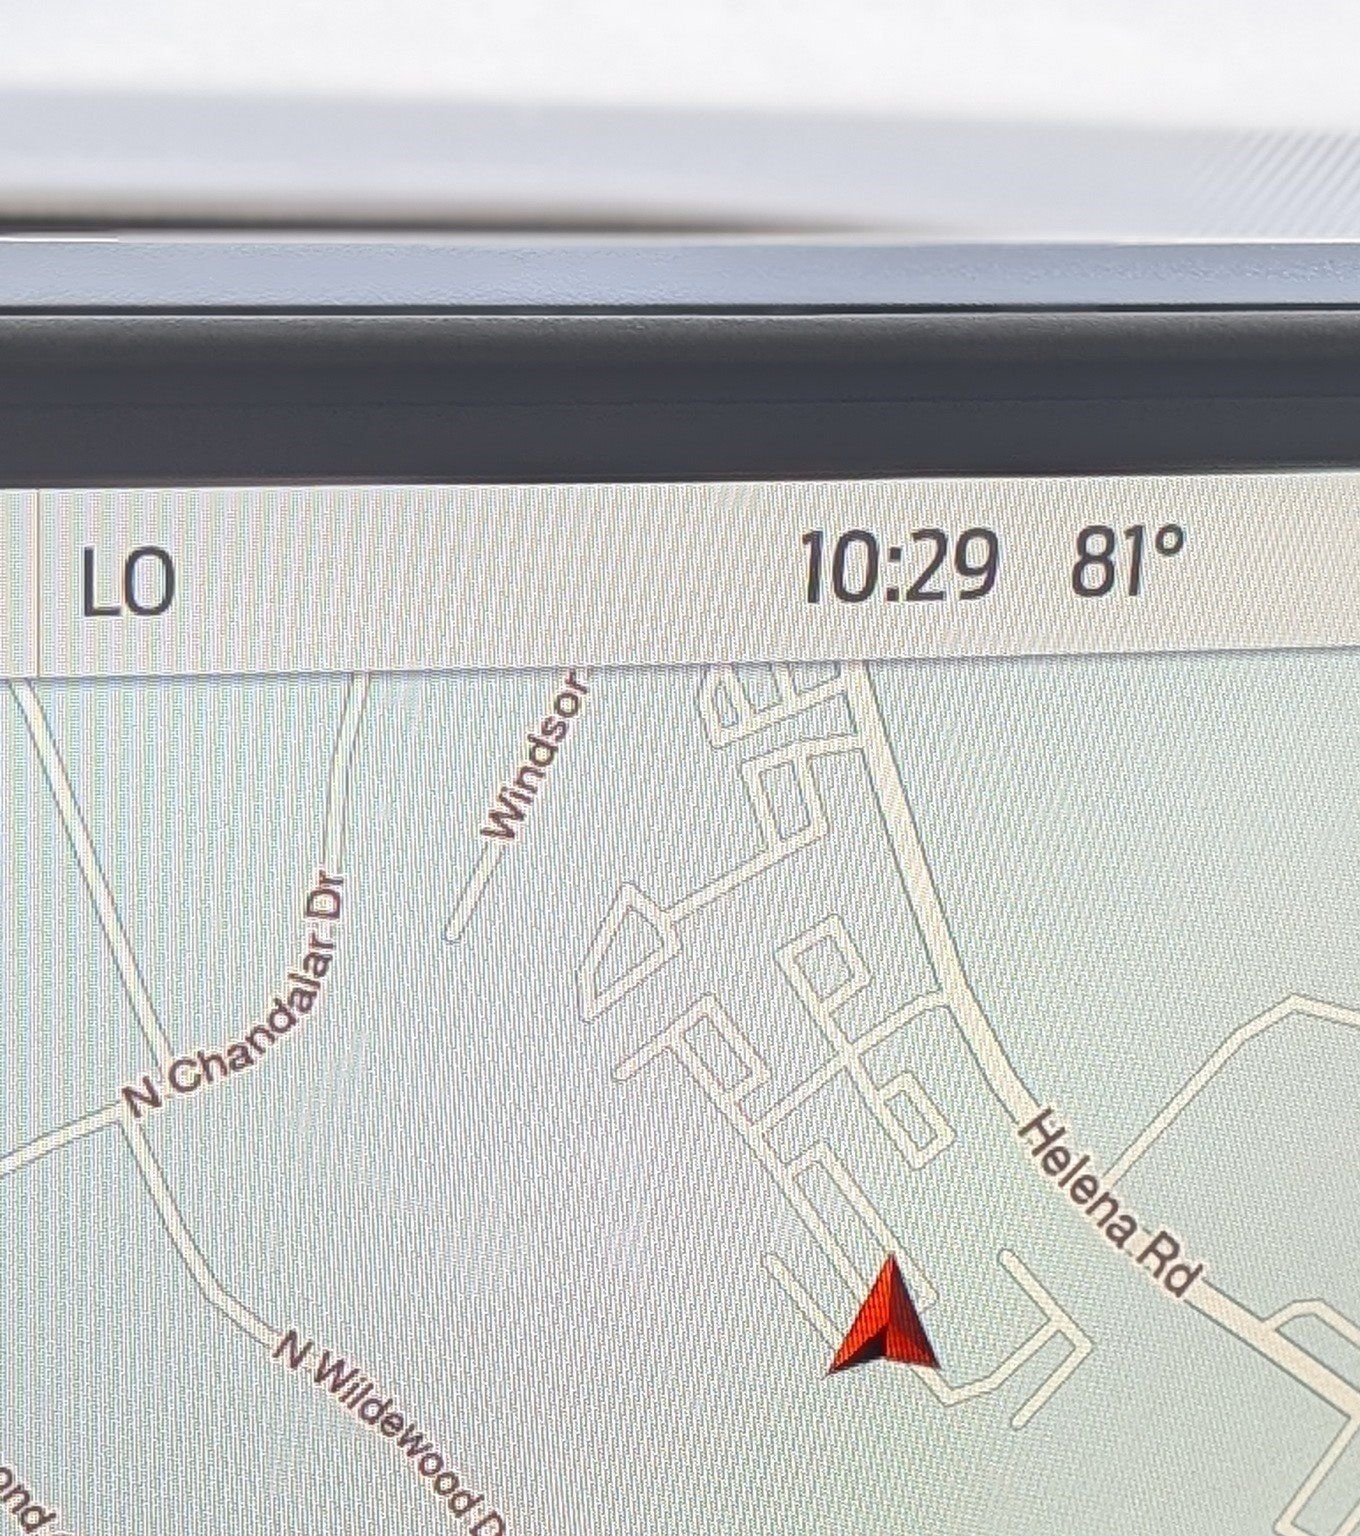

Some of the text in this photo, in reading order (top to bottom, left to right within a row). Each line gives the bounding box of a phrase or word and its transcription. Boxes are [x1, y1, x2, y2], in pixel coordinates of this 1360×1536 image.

[82, 545, 177, 617] LO
[801, 523, 1185, 604] 10:29 81°
[479, 668, 589, 839] Windsor
[121, 868, 345, 1119] N Chandalar Dr
[1017, 1106, 1204, 1299] Helena Rd
[272, 1329, 314, 1370] N
[314, 1350, 485, 1519] Wildewood
